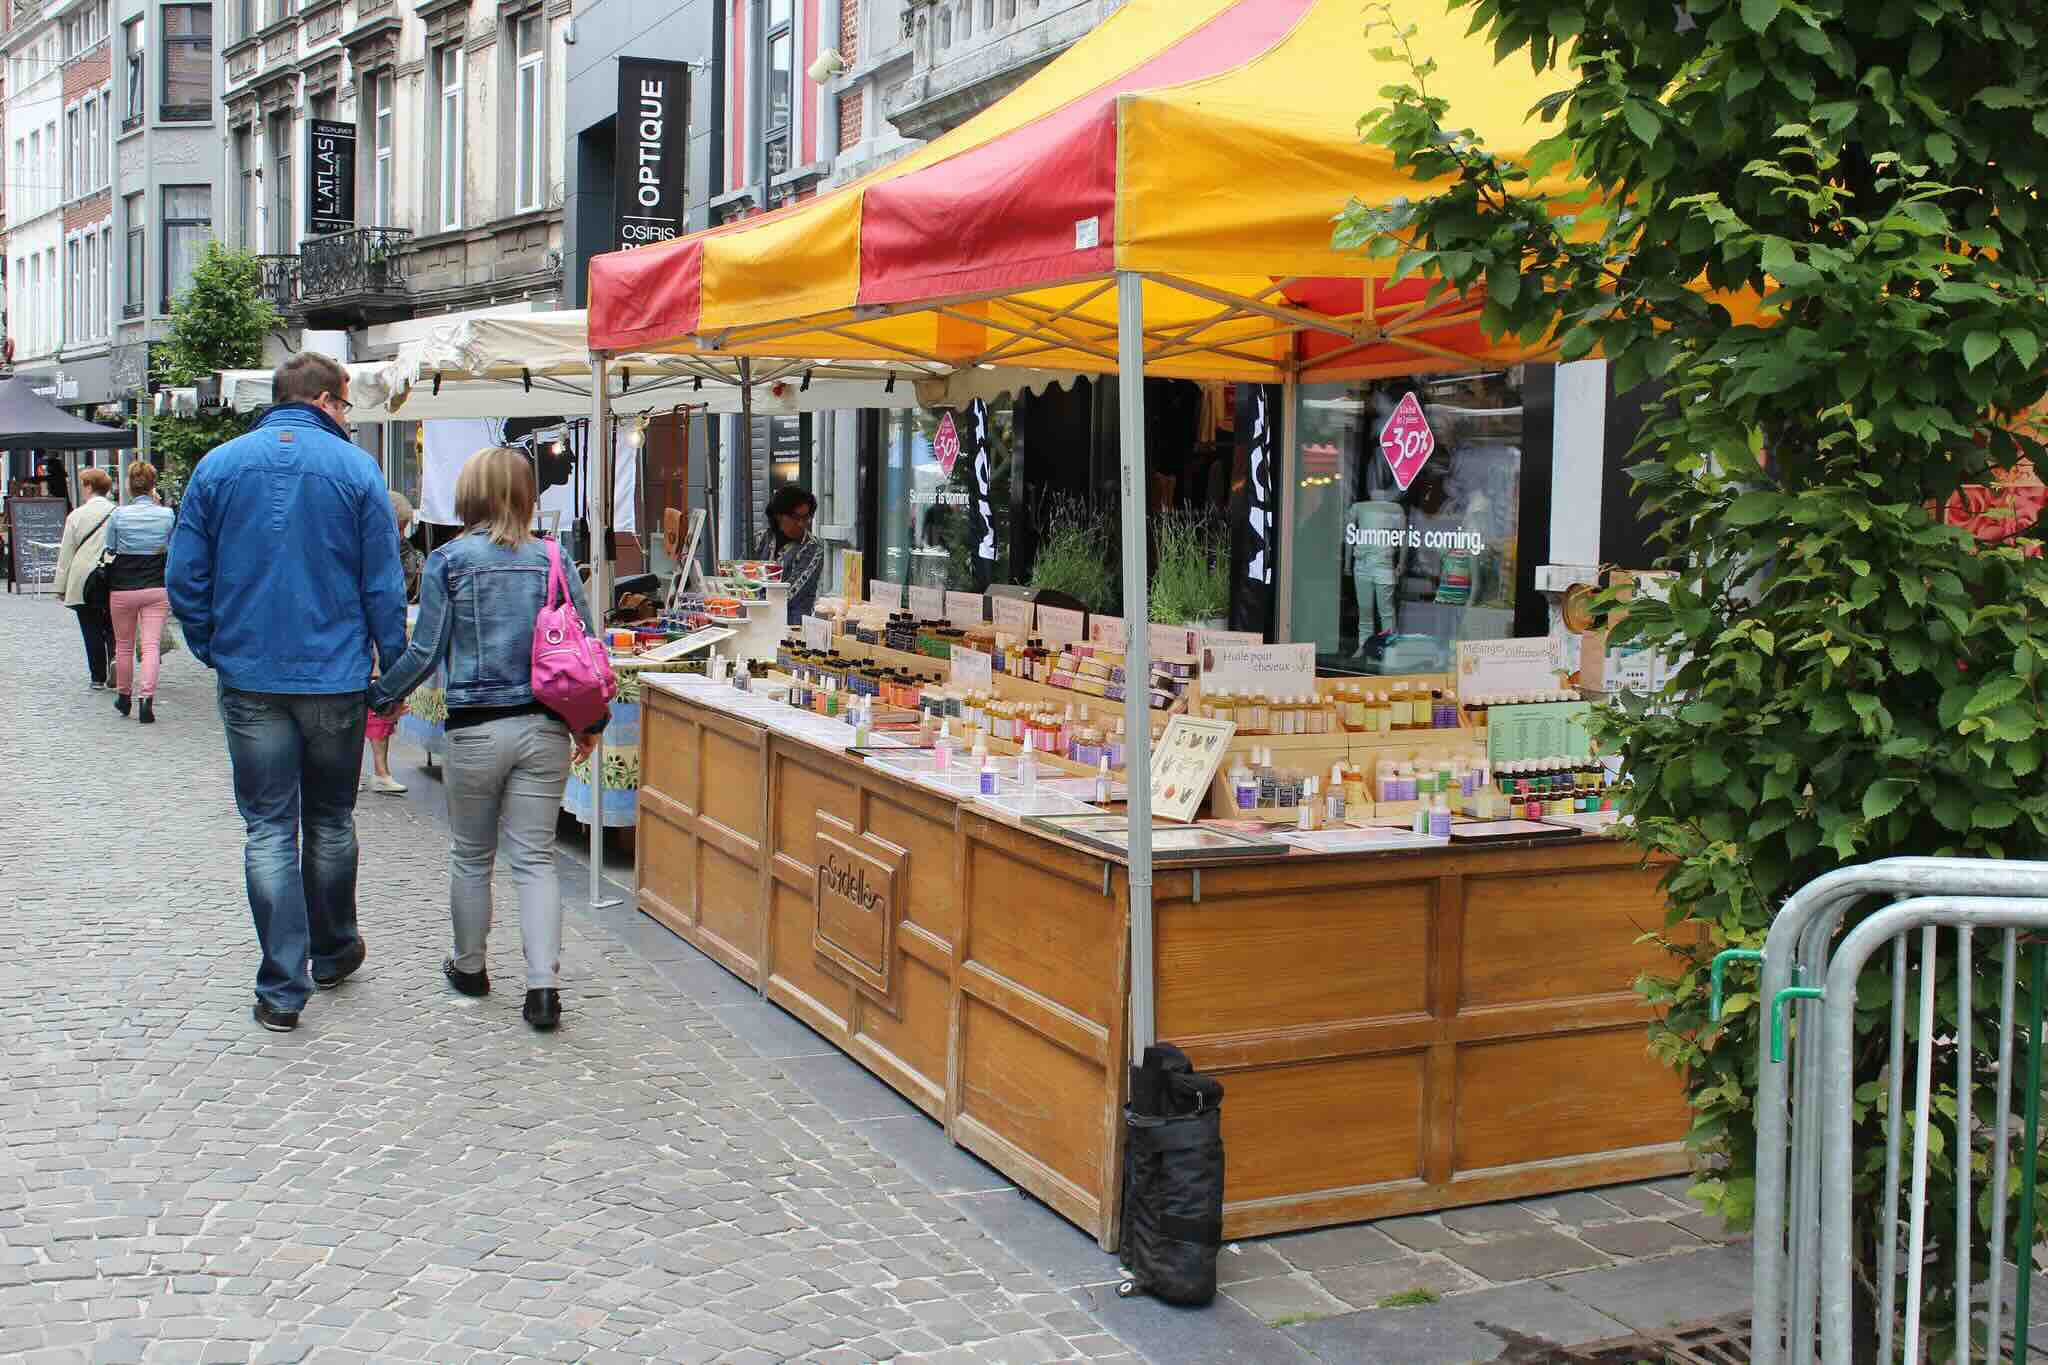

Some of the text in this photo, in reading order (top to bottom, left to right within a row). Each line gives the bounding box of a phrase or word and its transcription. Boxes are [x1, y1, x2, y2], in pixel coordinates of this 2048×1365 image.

[638, 79, 663, 208] OPTIQUE
[317, 138, 334, 214] L'ATLAS
[622, 224, 675, 241] OSIRIS
[1382, 427, 1428, 469] -30%
[1345, 523, 1485, 555] Summer is coming.
